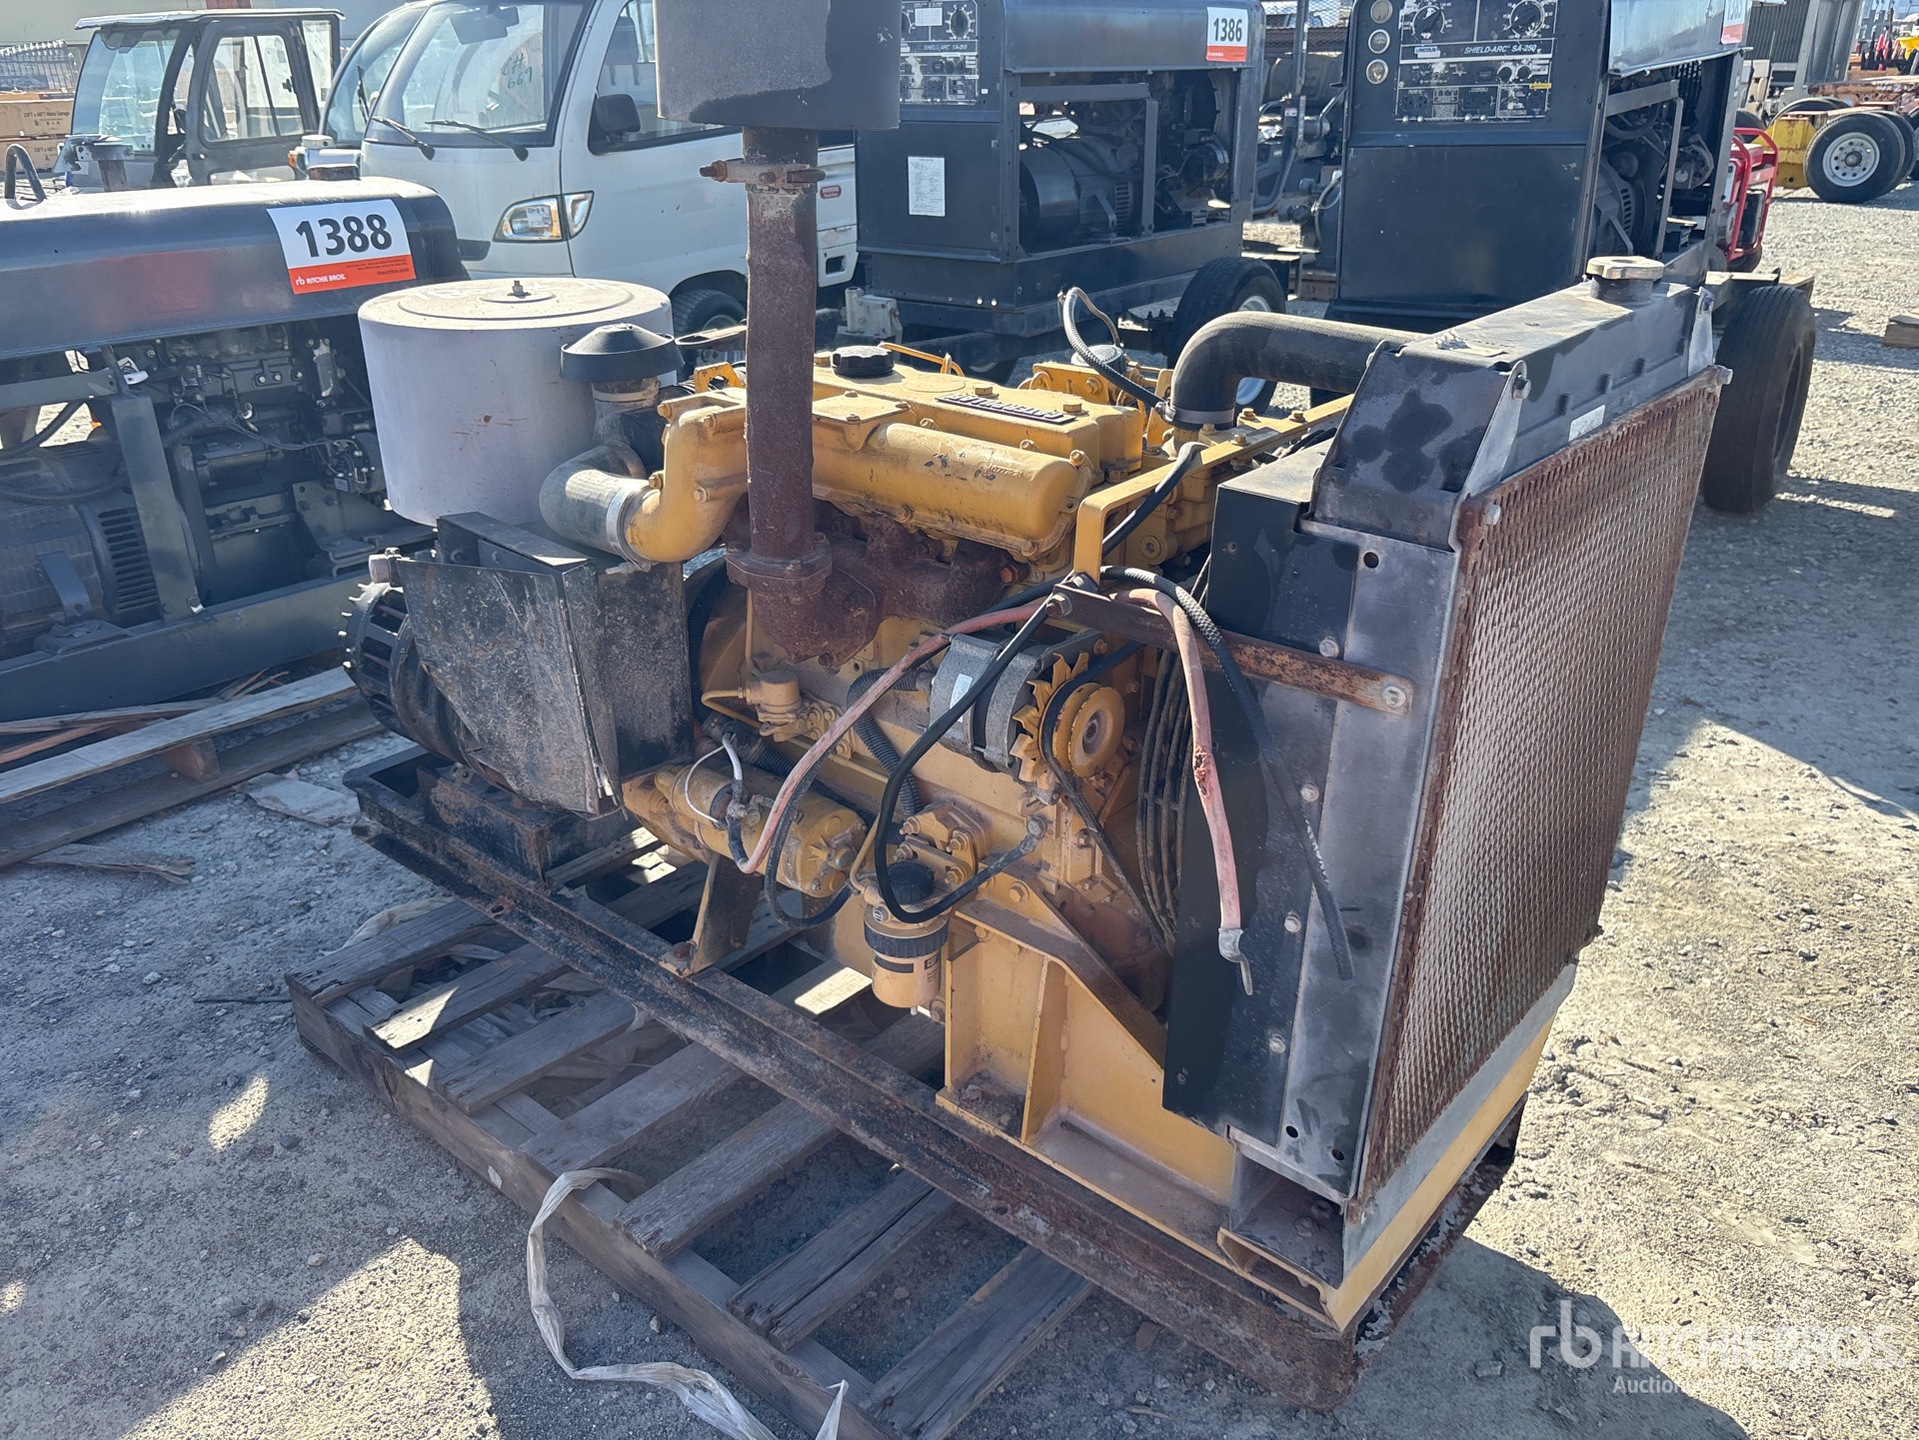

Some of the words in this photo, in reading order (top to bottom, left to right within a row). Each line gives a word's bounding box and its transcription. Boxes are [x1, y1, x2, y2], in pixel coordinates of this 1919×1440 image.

[1213, 17, 1243, 42] 1386
[1511, 44, 1537, 52] SA-250
[295, 213, 393, 258] 1388
[295, 276, 306, 287] rb
[306, 276, 329, 285] RITCHIE
